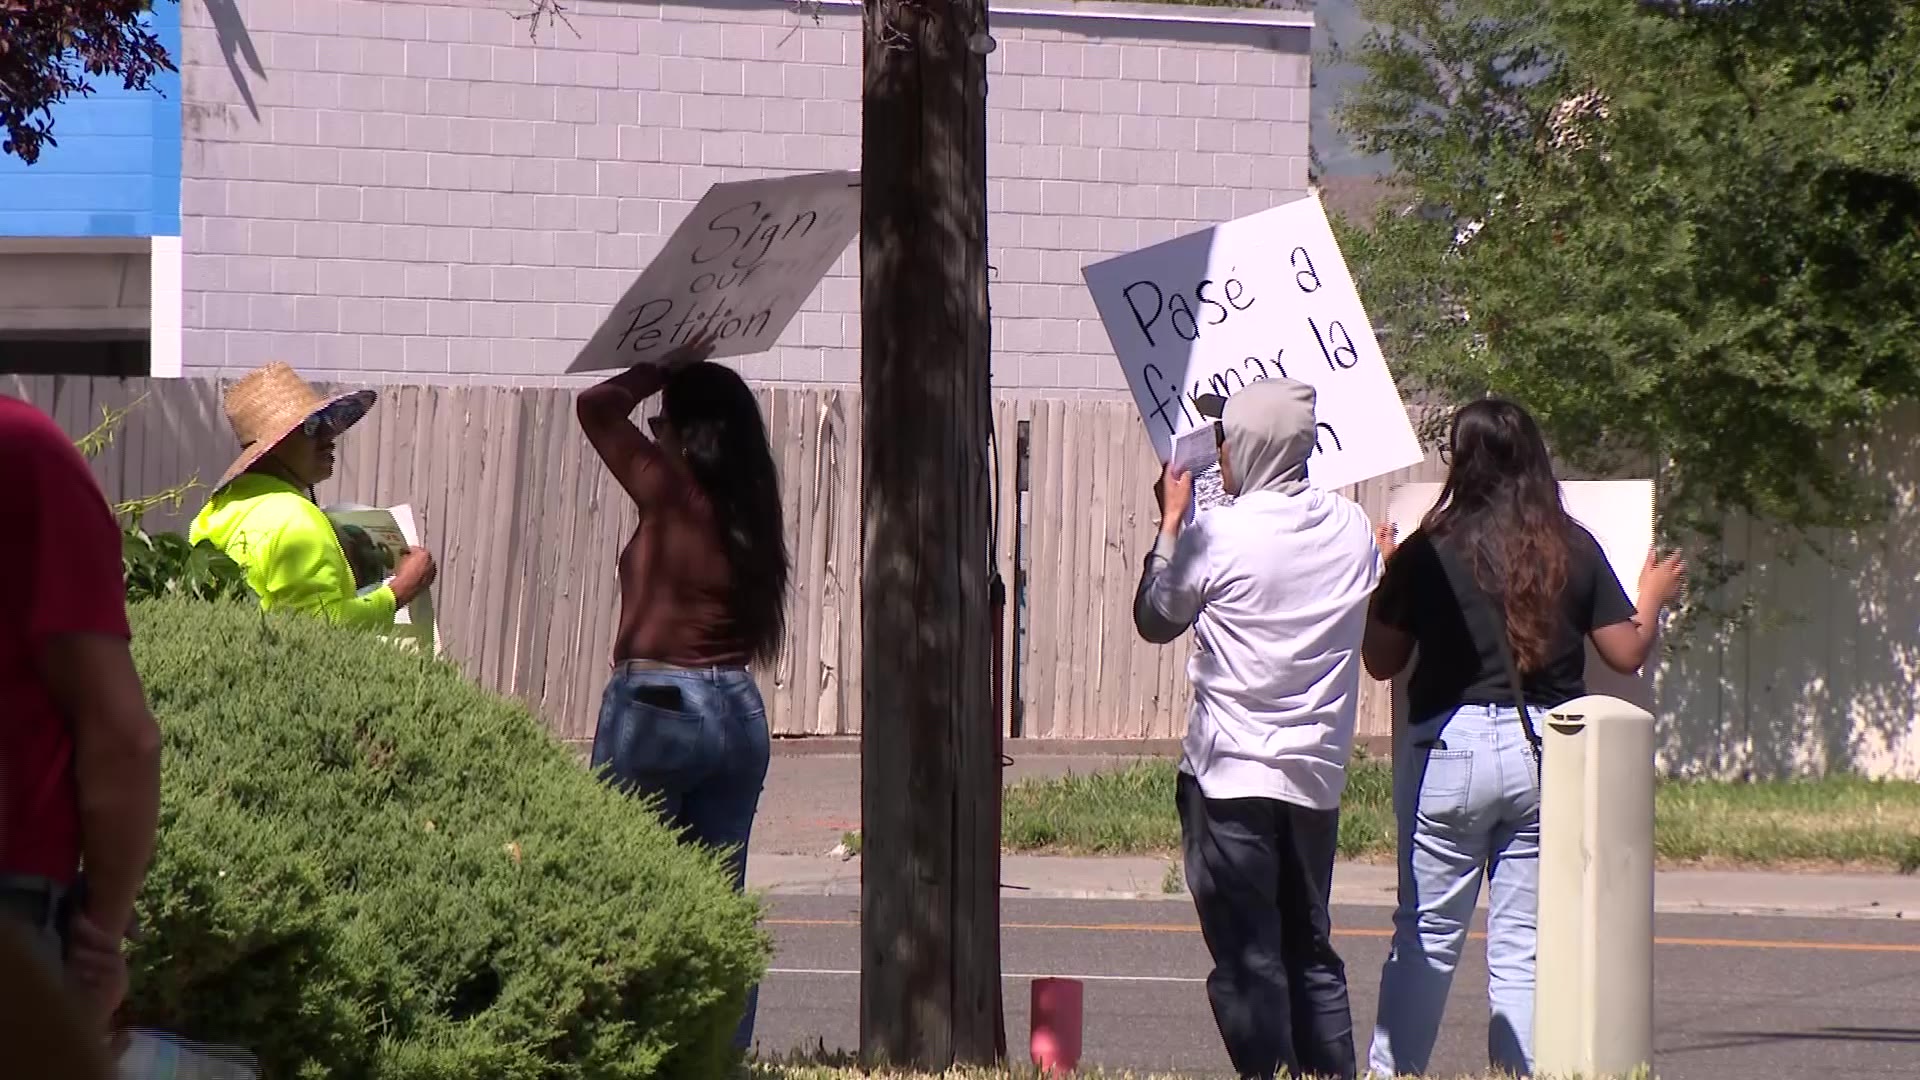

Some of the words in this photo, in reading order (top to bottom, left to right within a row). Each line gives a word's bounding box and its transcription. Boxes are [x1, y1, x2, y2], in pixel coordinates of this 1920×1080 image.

[692, 201, 816, 268] Sign
[690, 264, 764, 293] our
[1123, 266, 1255, 347] Pasé
[1291, 247, 1321, 292] a
[616, 298, 771, 352] Petition
[1307, 317, 1358, 371] la
